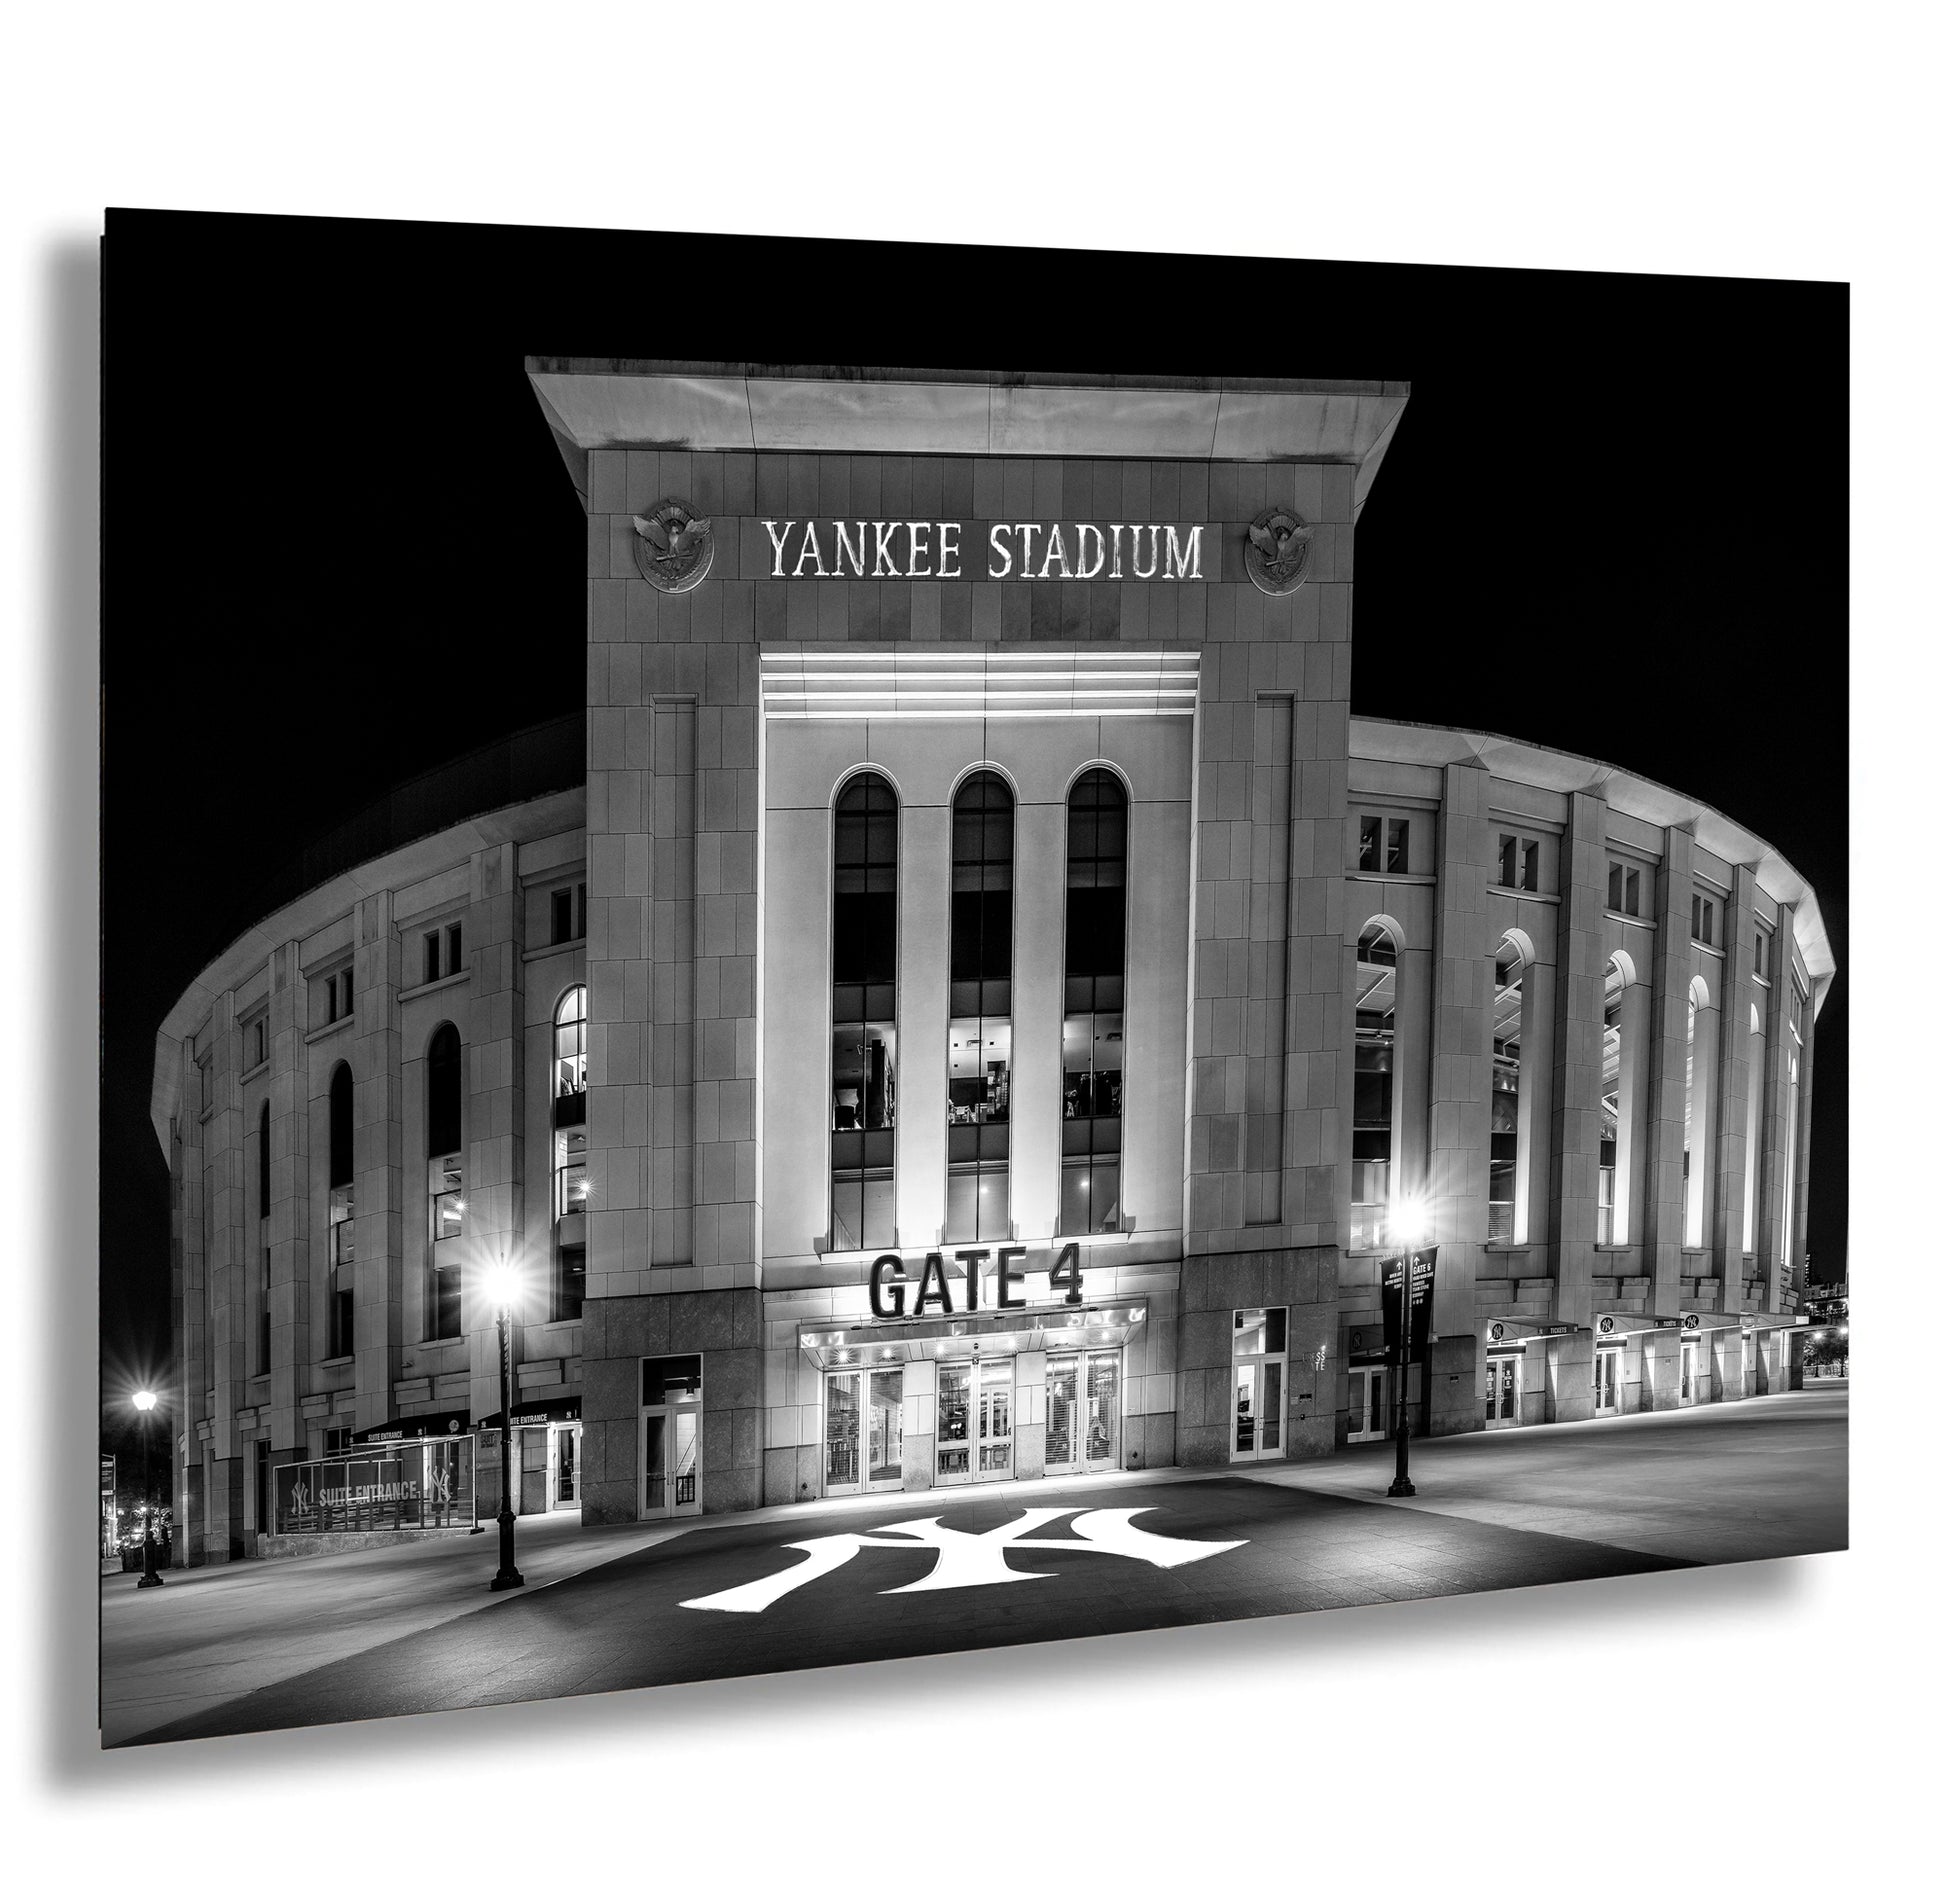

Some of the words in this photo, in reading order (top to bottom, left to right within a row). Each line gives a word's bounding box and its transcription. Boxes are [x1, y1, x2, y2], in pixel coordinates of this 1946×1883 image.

[761, 520, 961, 578] YANKEE
[988, 523, 1205, 580] STADIUM
[869, 1246, 1027, 1321] GATE
[1048, 1242, 1084, 1306] 4
[1550, 1326, 1567, 1334] TICKETS
[520, 1413, 548, 1425] ENTRANCE
[367, 1433, 380, 1442] SUITE
[380, 1430, 403, 1441] ENTRANCE
[319, 1486, 353, 1508] SUITE
[355, 1480, 418, 1505] ENTRANCE
